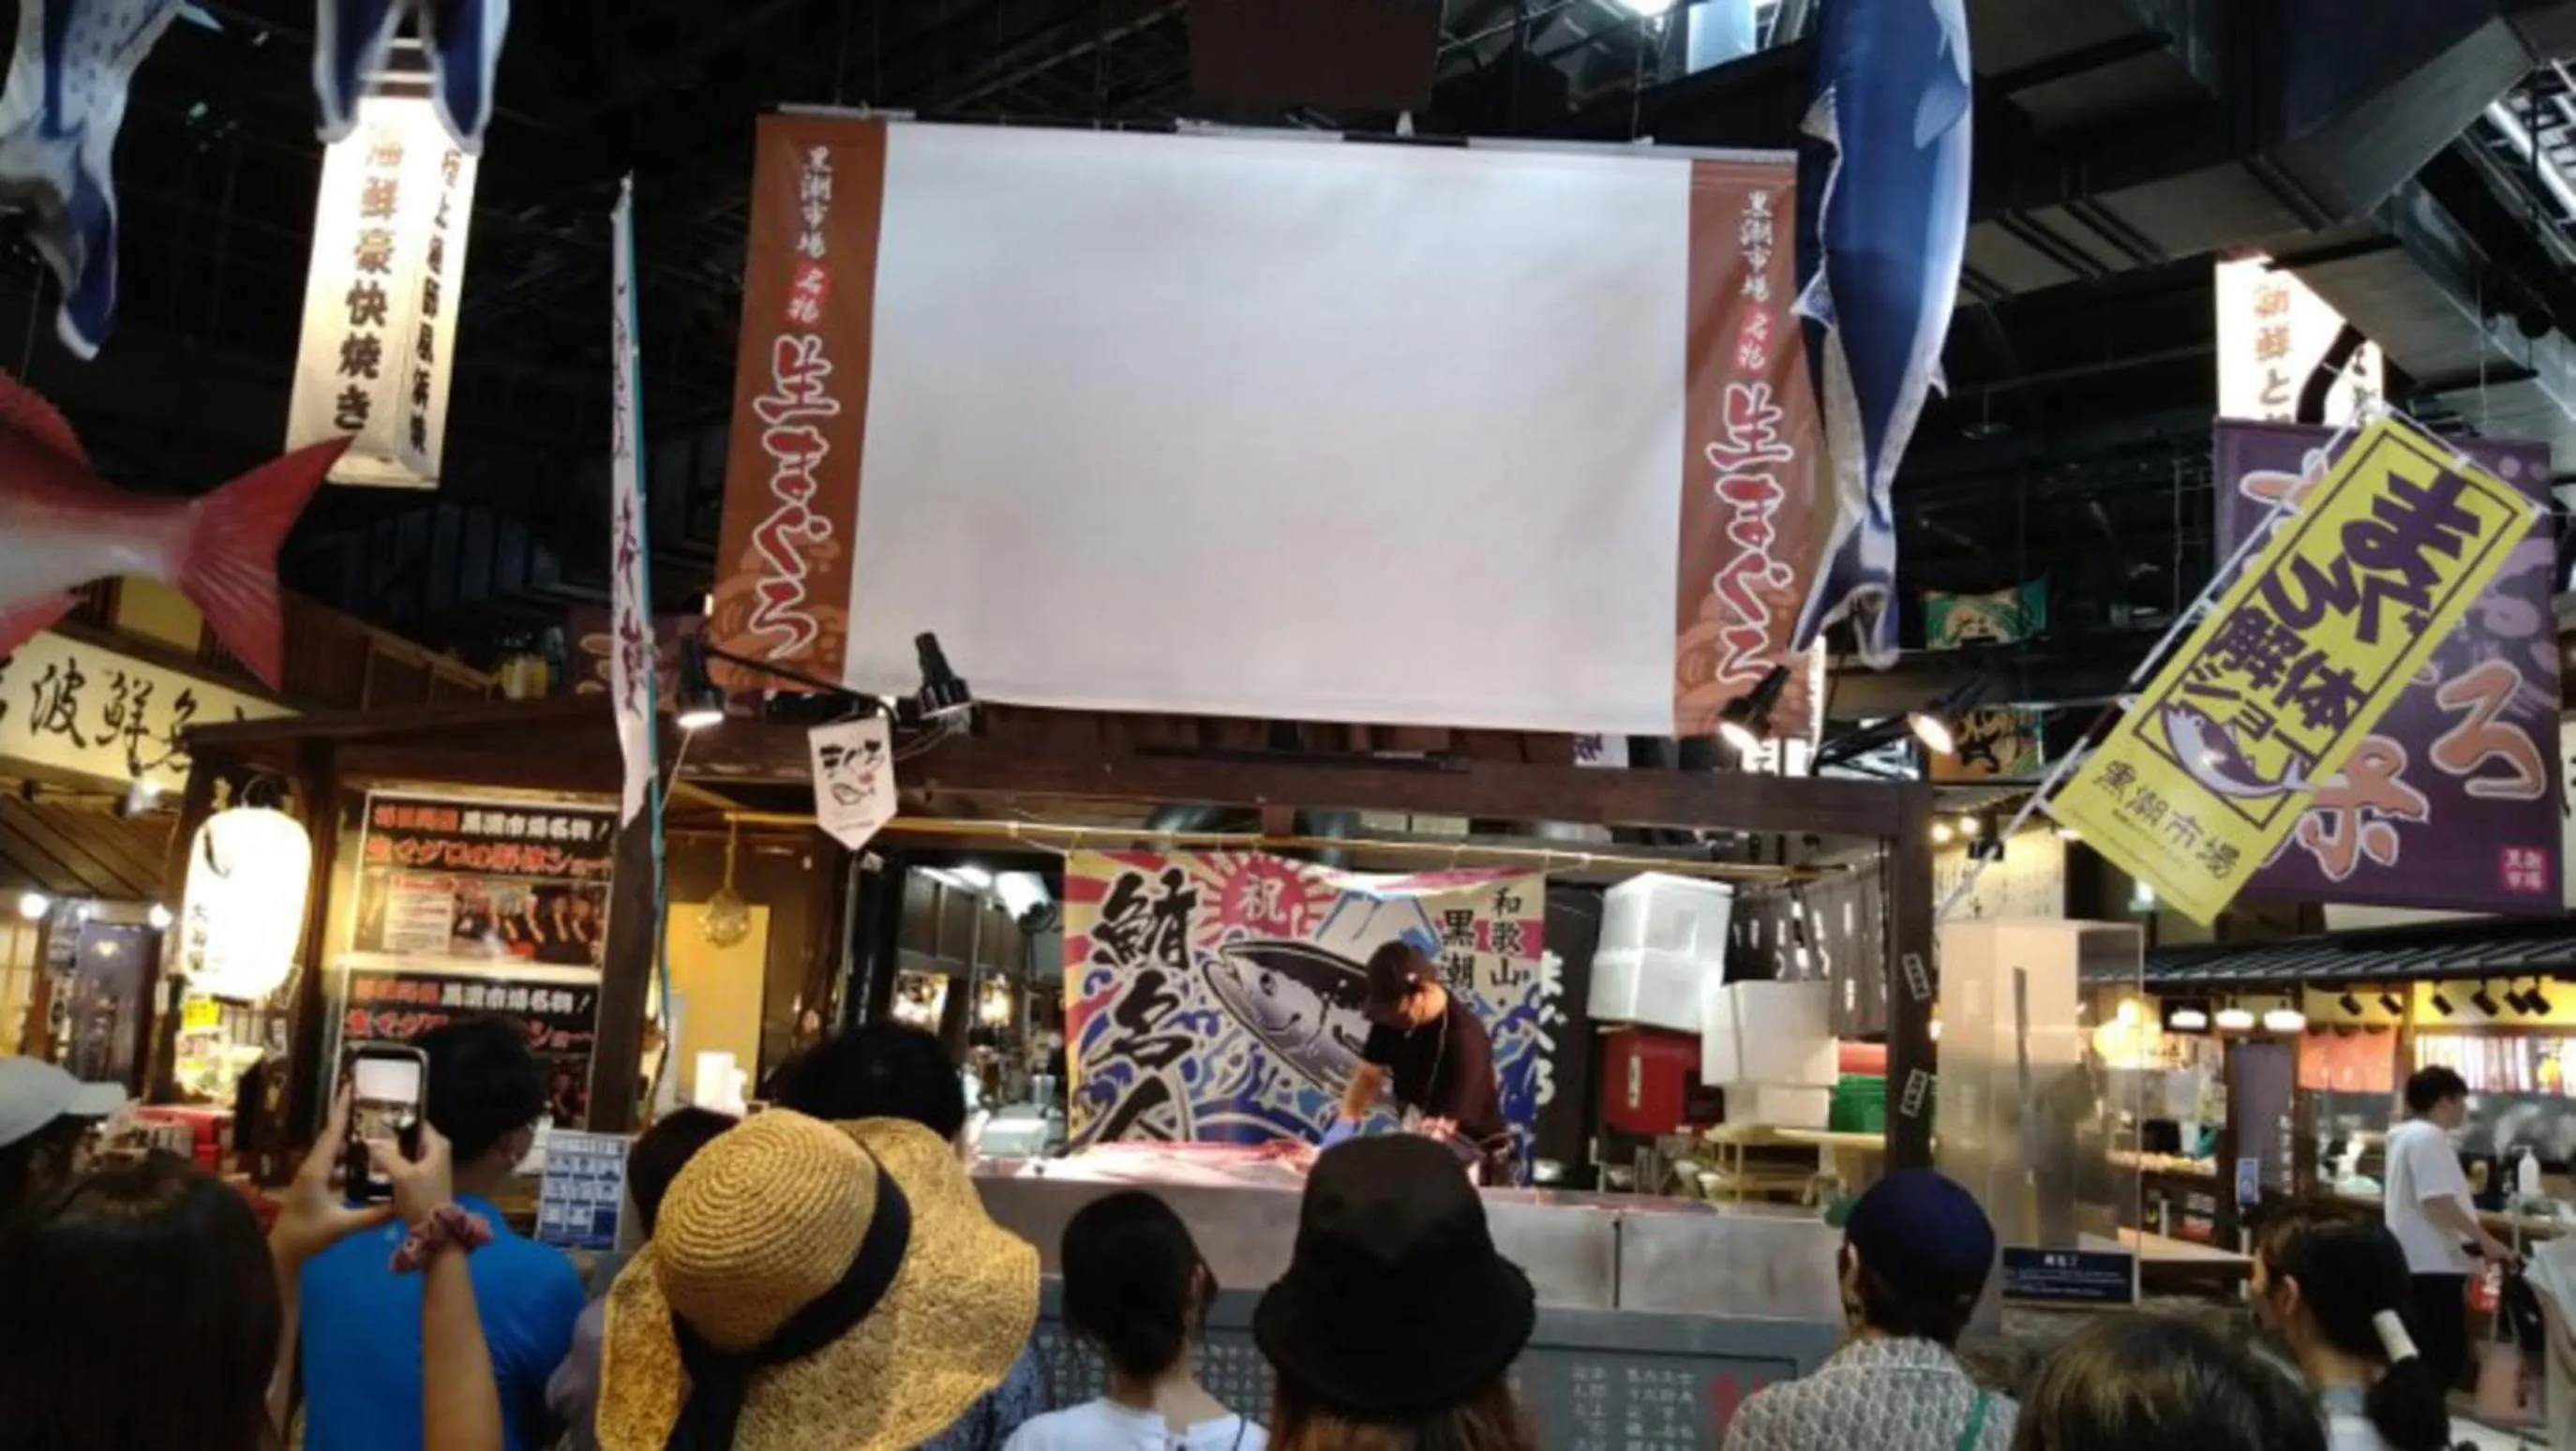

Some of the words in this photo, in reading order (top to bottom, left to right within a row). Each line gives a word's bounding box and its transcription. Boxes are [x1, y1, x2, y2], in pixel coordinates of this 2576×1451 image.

[0, 653, 246, 777] 波鮮魚
[2209, 605, 2367, 733] 解体
[1241, 875, 1285, 921] 祝
[1490, 888, 1521, 987] 和歌山
[1440, 909, 1475, 1010] 黒潮
